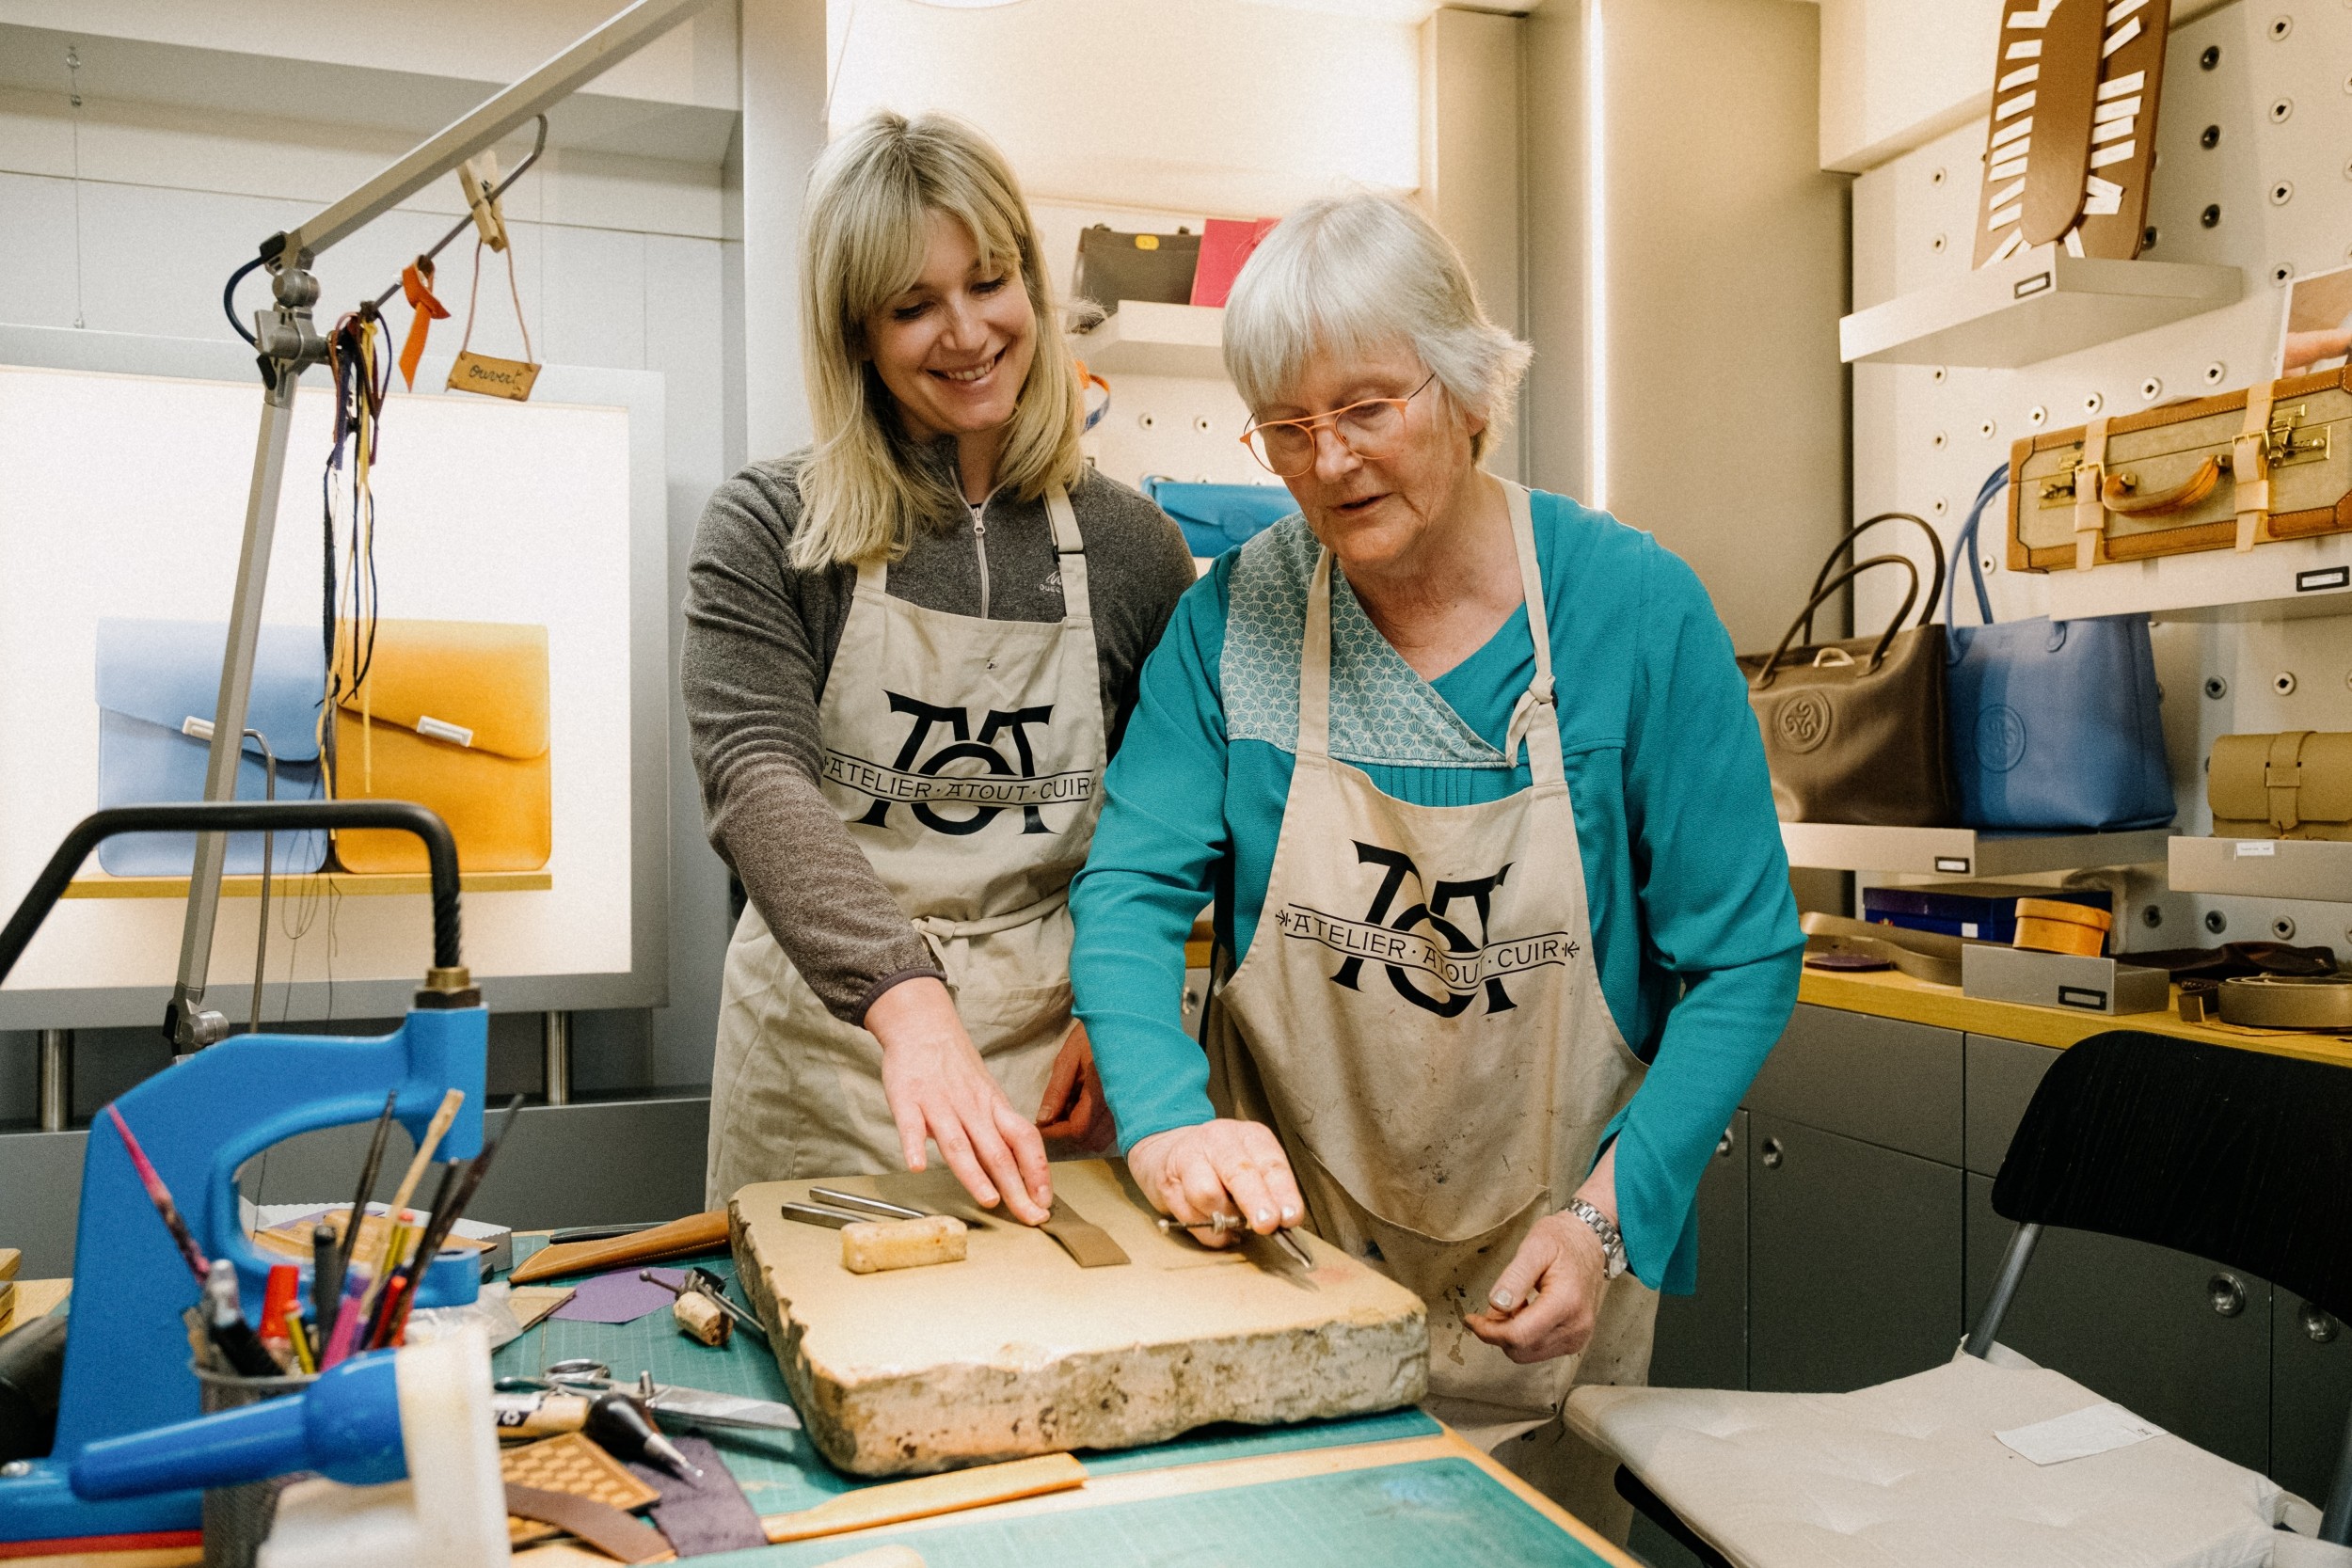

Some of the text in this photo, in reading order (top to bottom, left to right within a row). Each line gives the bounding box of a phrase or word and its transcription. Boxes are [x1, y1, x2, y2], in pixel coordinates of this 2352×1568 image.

[830, 756, 1090, 801] ATELIER ATOUT CUIR
[1293, 912, 1407, 959] ATELIER
[1497, 940, 1560, 969] CUIR
